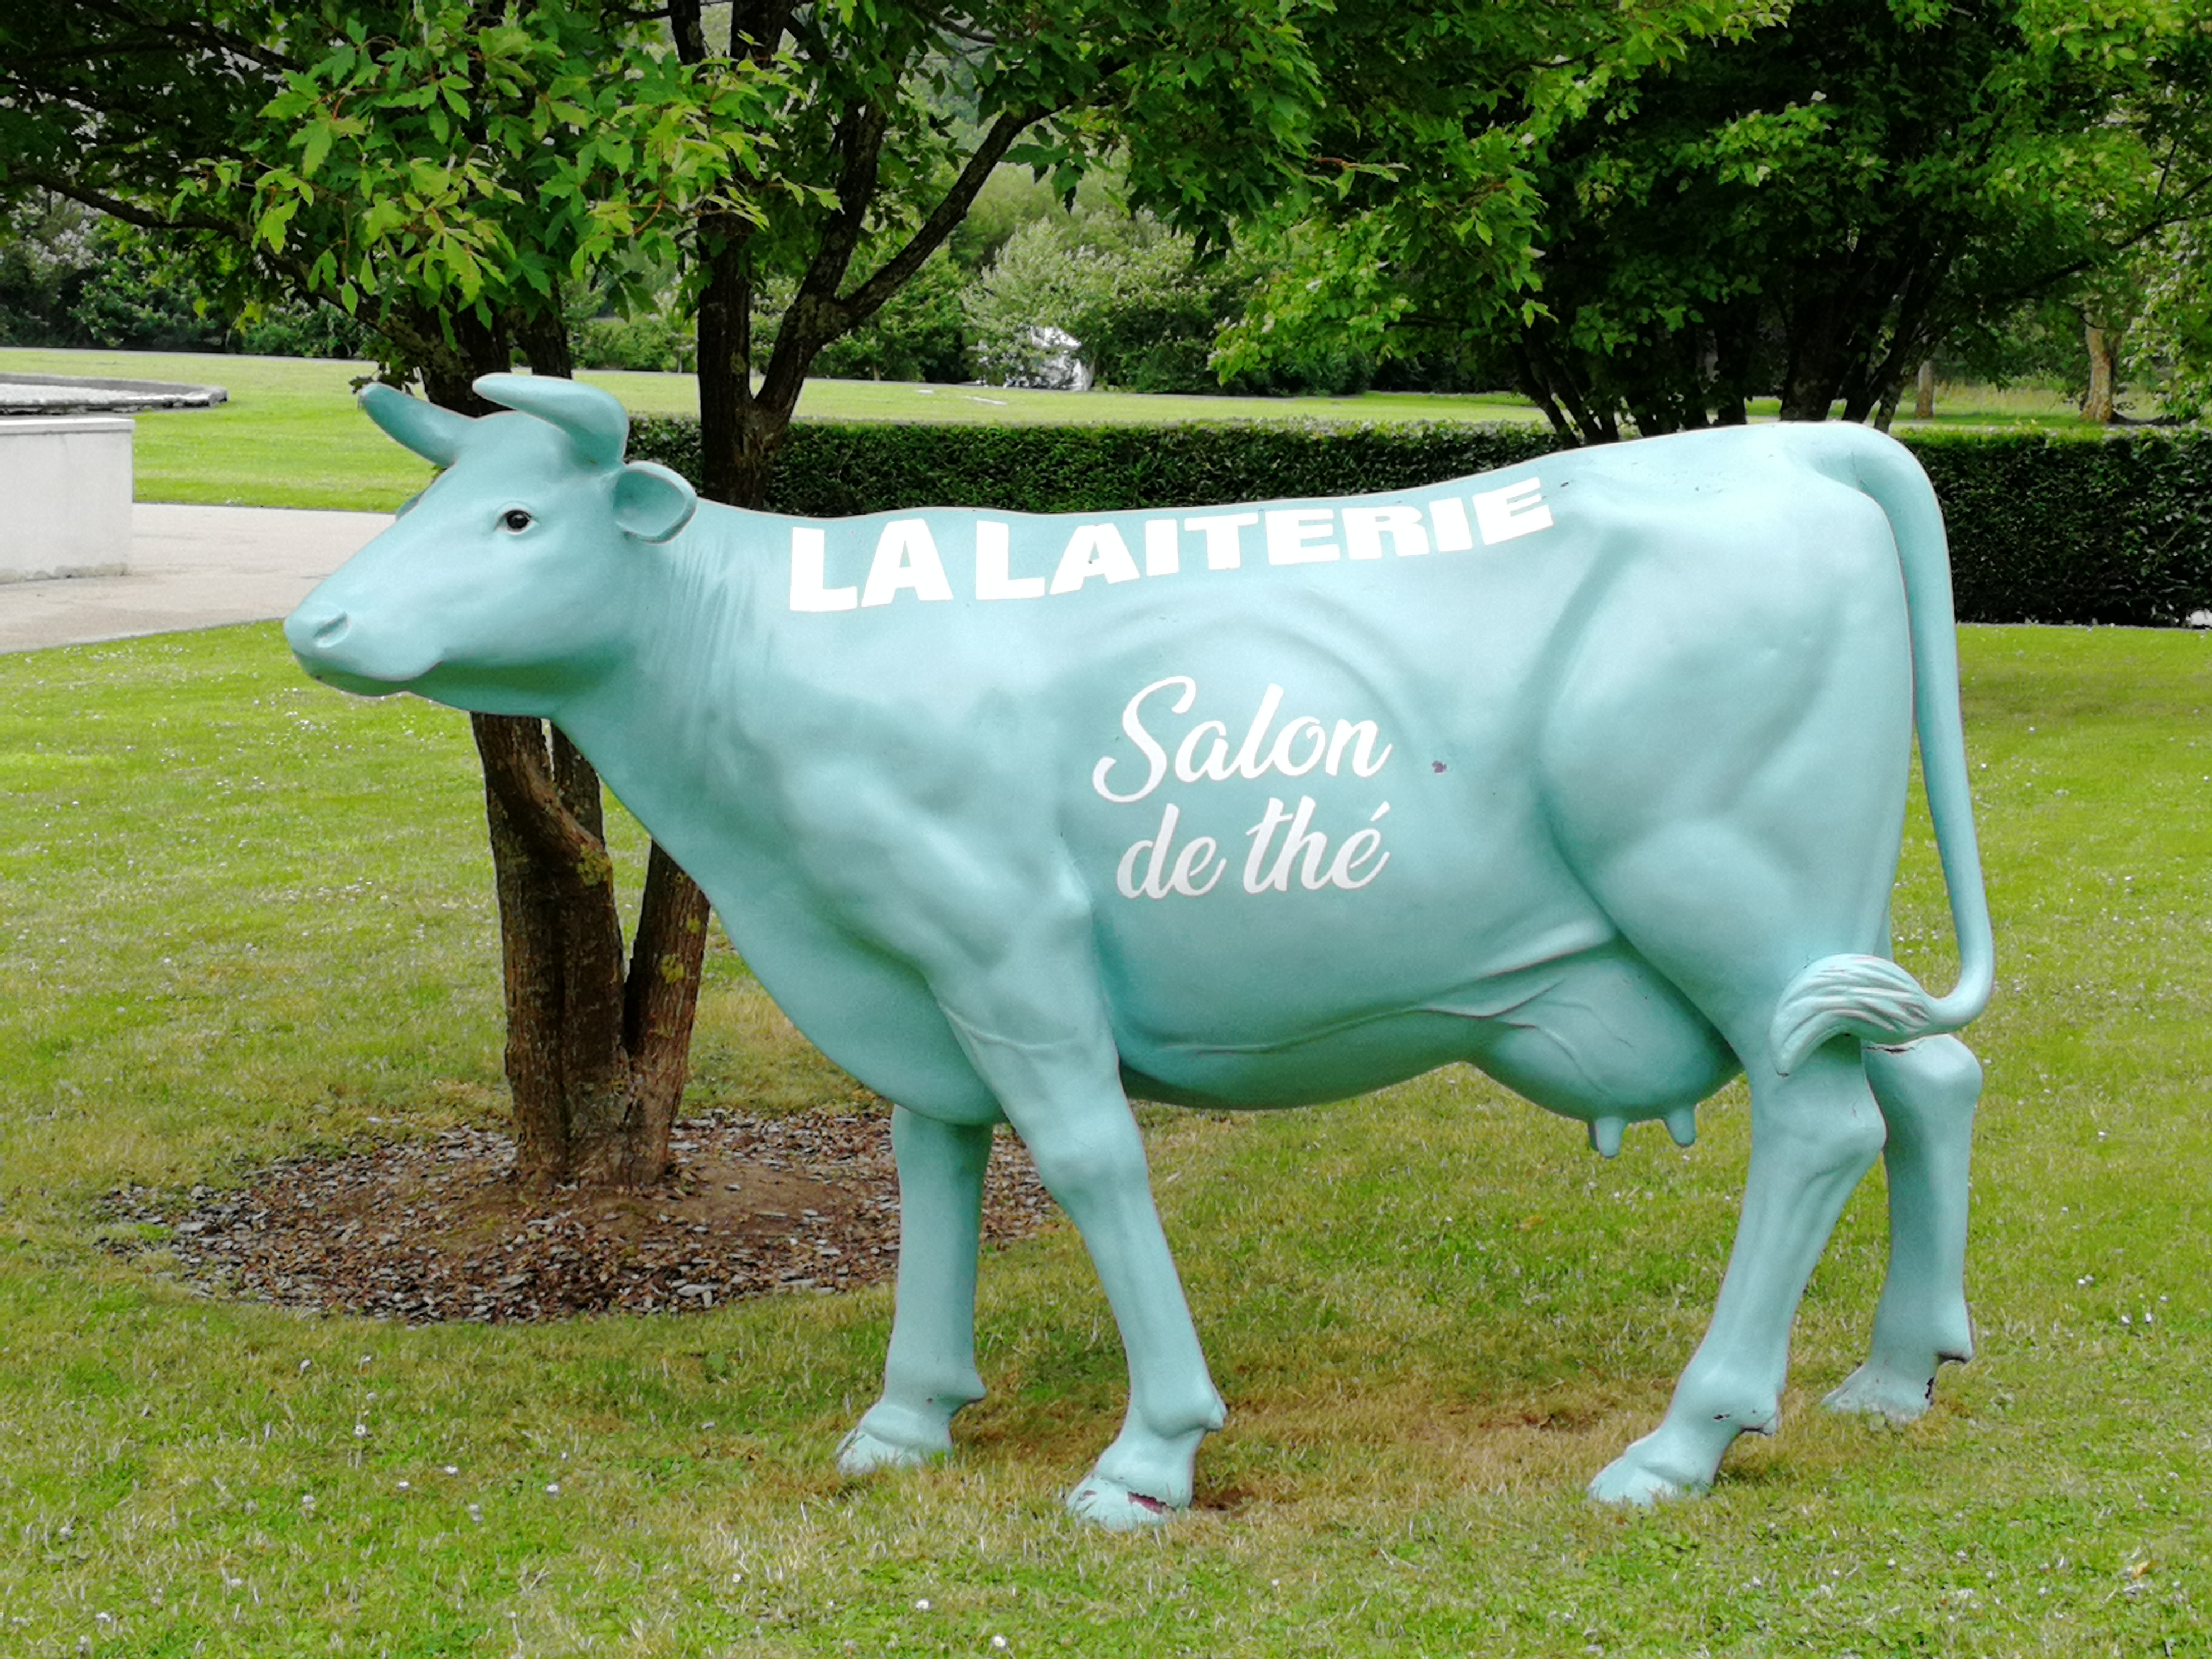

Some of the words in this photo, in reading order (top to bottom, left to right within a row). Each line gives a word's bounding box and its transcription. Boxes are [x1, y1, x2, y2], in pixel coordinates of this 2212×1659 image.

[789, 518, 954, 612] LA
[975, 477, 1554, 600] LAITERIE
[1092, 675, 1393, 803] Salon
[1117, 803, 1227, 899] de
[1243, 795, 1391, 894] thé
